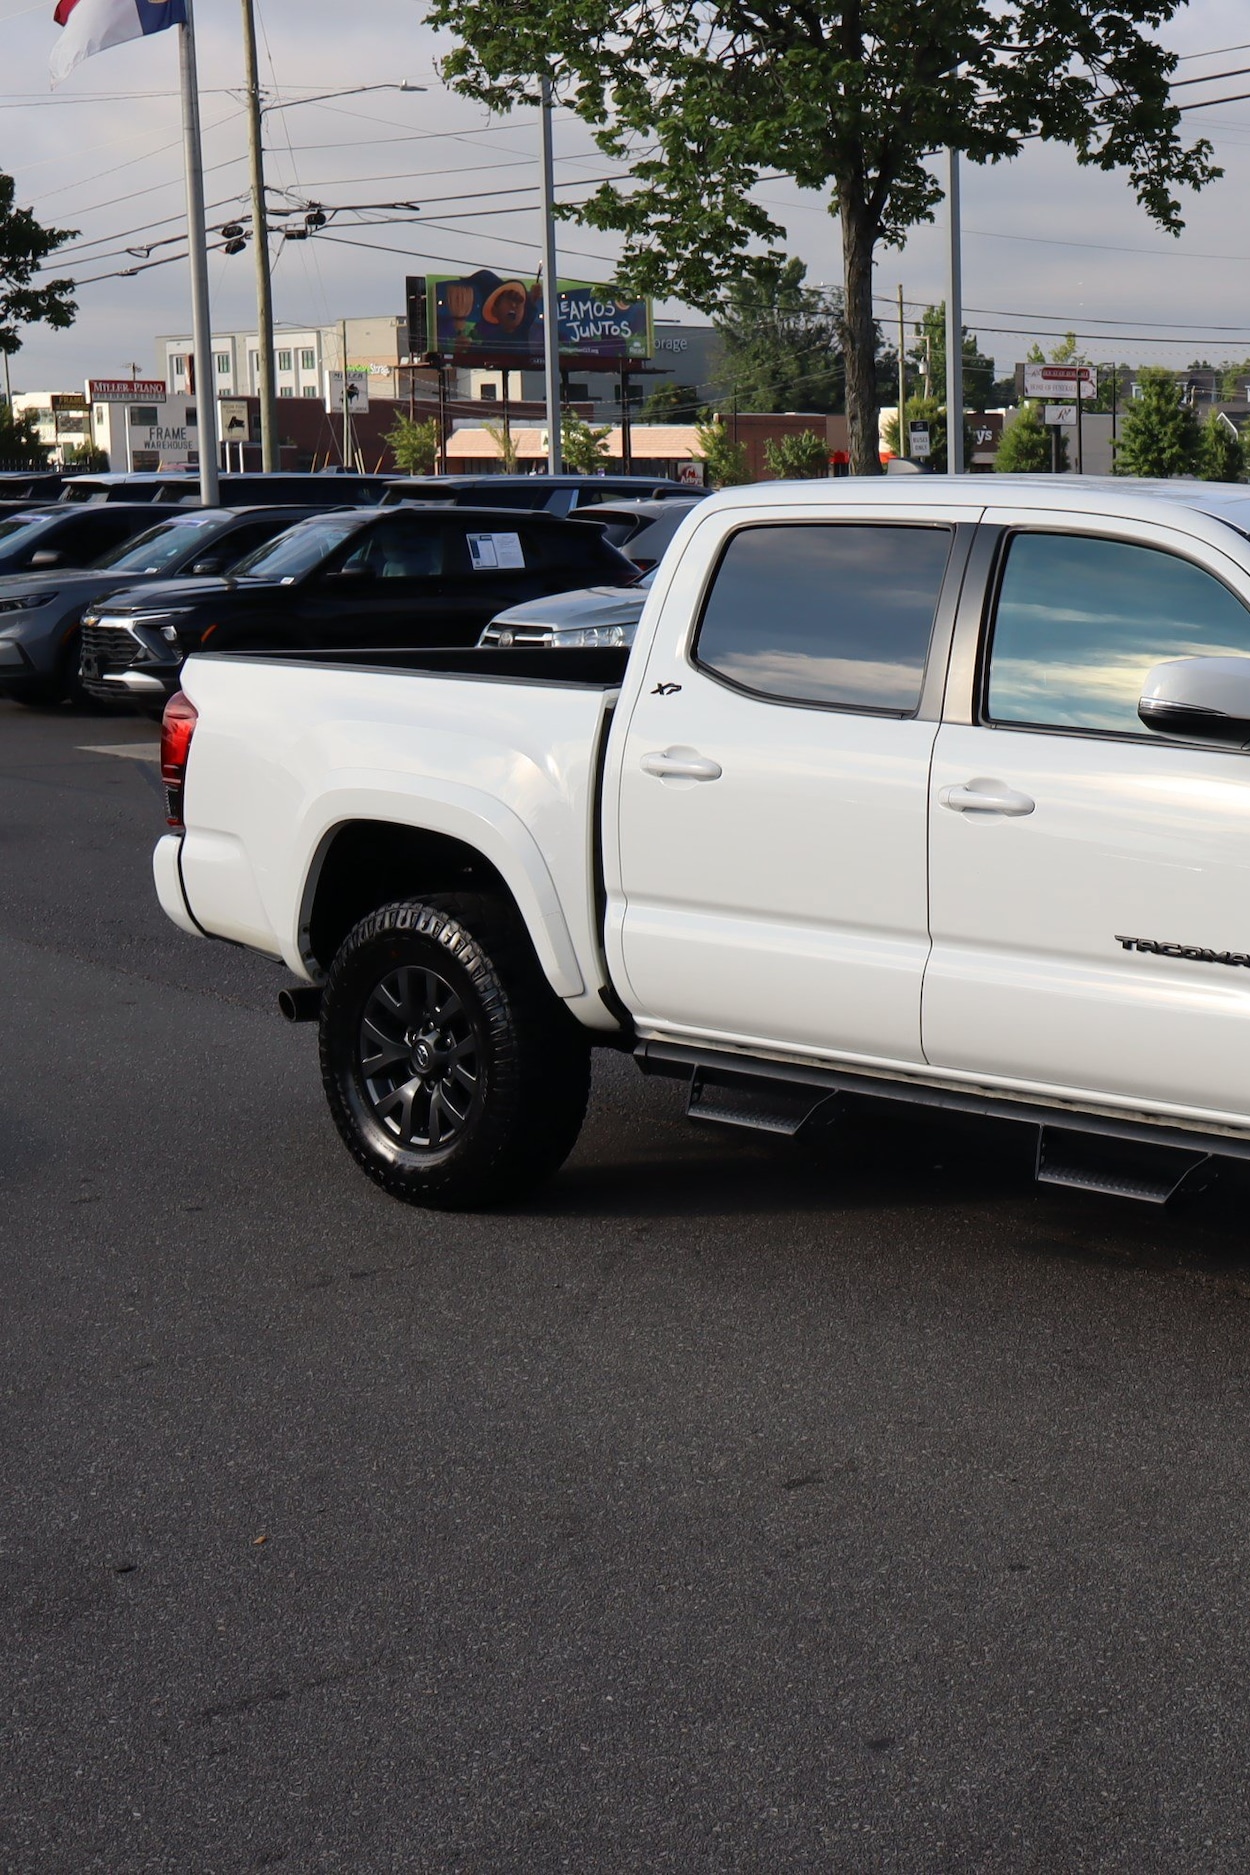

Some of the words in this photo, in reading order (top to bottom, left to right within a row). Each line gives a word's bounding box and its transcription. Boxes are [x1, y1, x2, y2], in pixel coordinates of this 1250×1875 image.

[557, 300, 615, 321] LEAMOS
[566, 320, 632, 342] JUNTOS
[654, 337, 688, 350] orage
[333, 372, 363, 380] MILER
[94, 381, 129, 393] MILLER
[133, 382, 163, 394] PIANO
[149, 427, 187, 441] FRAME
[144, 440, 193, 450] WAREHOUSE
[650, 683, 682, 696] XP
